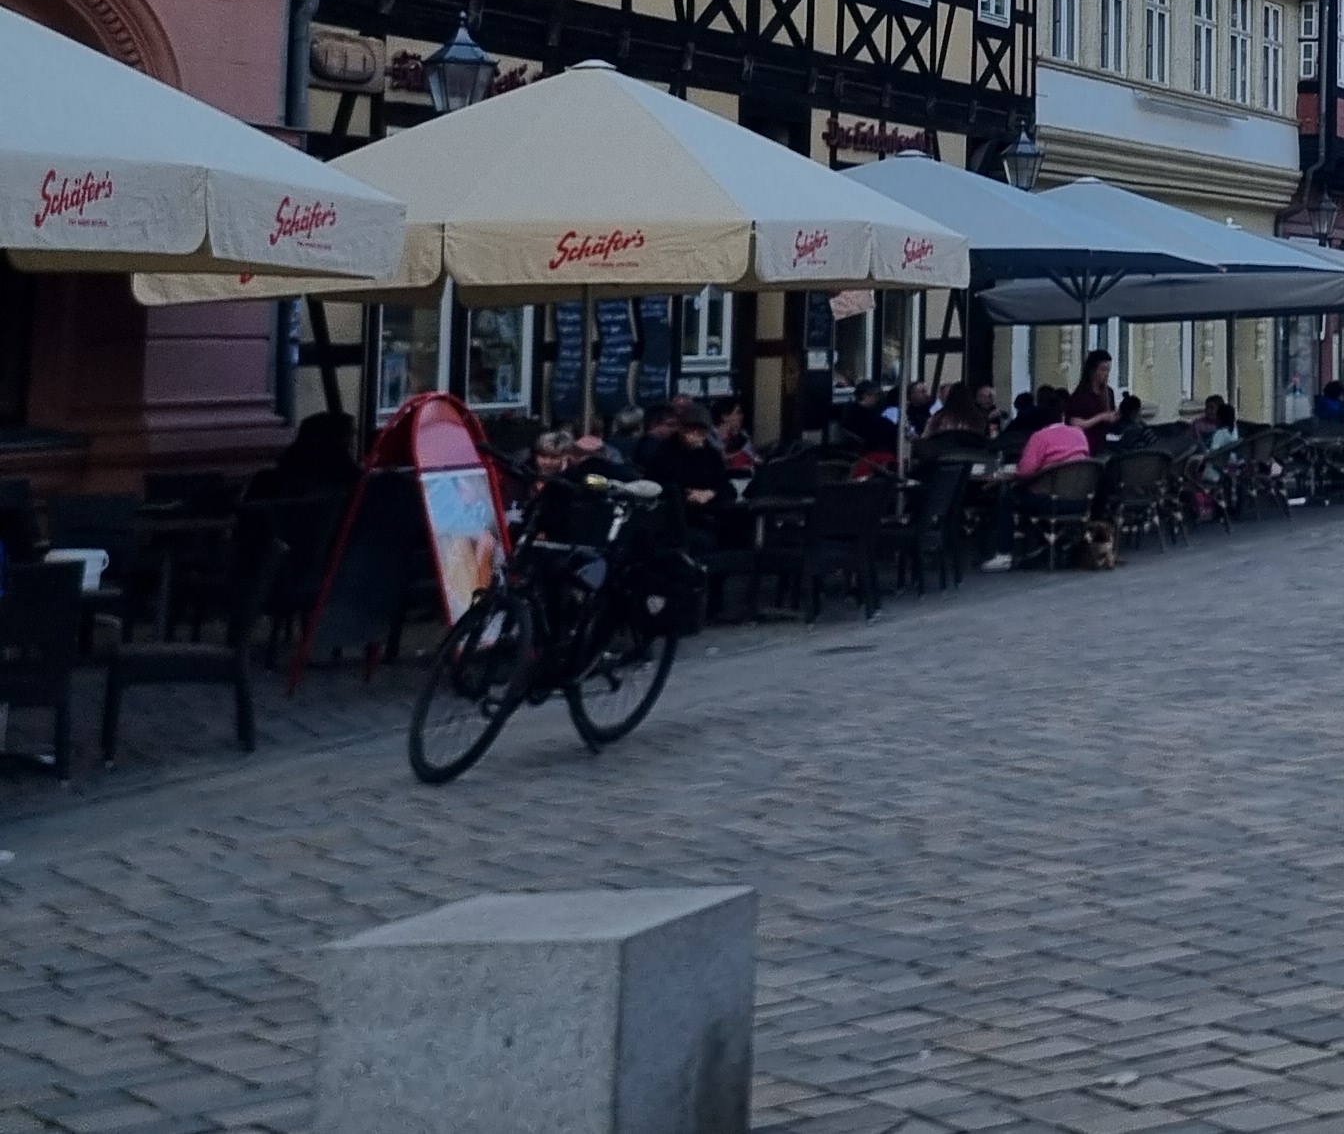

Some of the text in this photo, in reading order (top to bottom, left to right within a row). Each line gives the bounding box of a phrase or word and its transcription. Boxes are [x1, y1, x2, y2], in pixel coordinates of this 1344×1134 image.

[34, 169, 113, 228] Schäfer's
[269, 195, 337, 245] Schäfer's
[548, 229, 645, 270] Schäfer's
